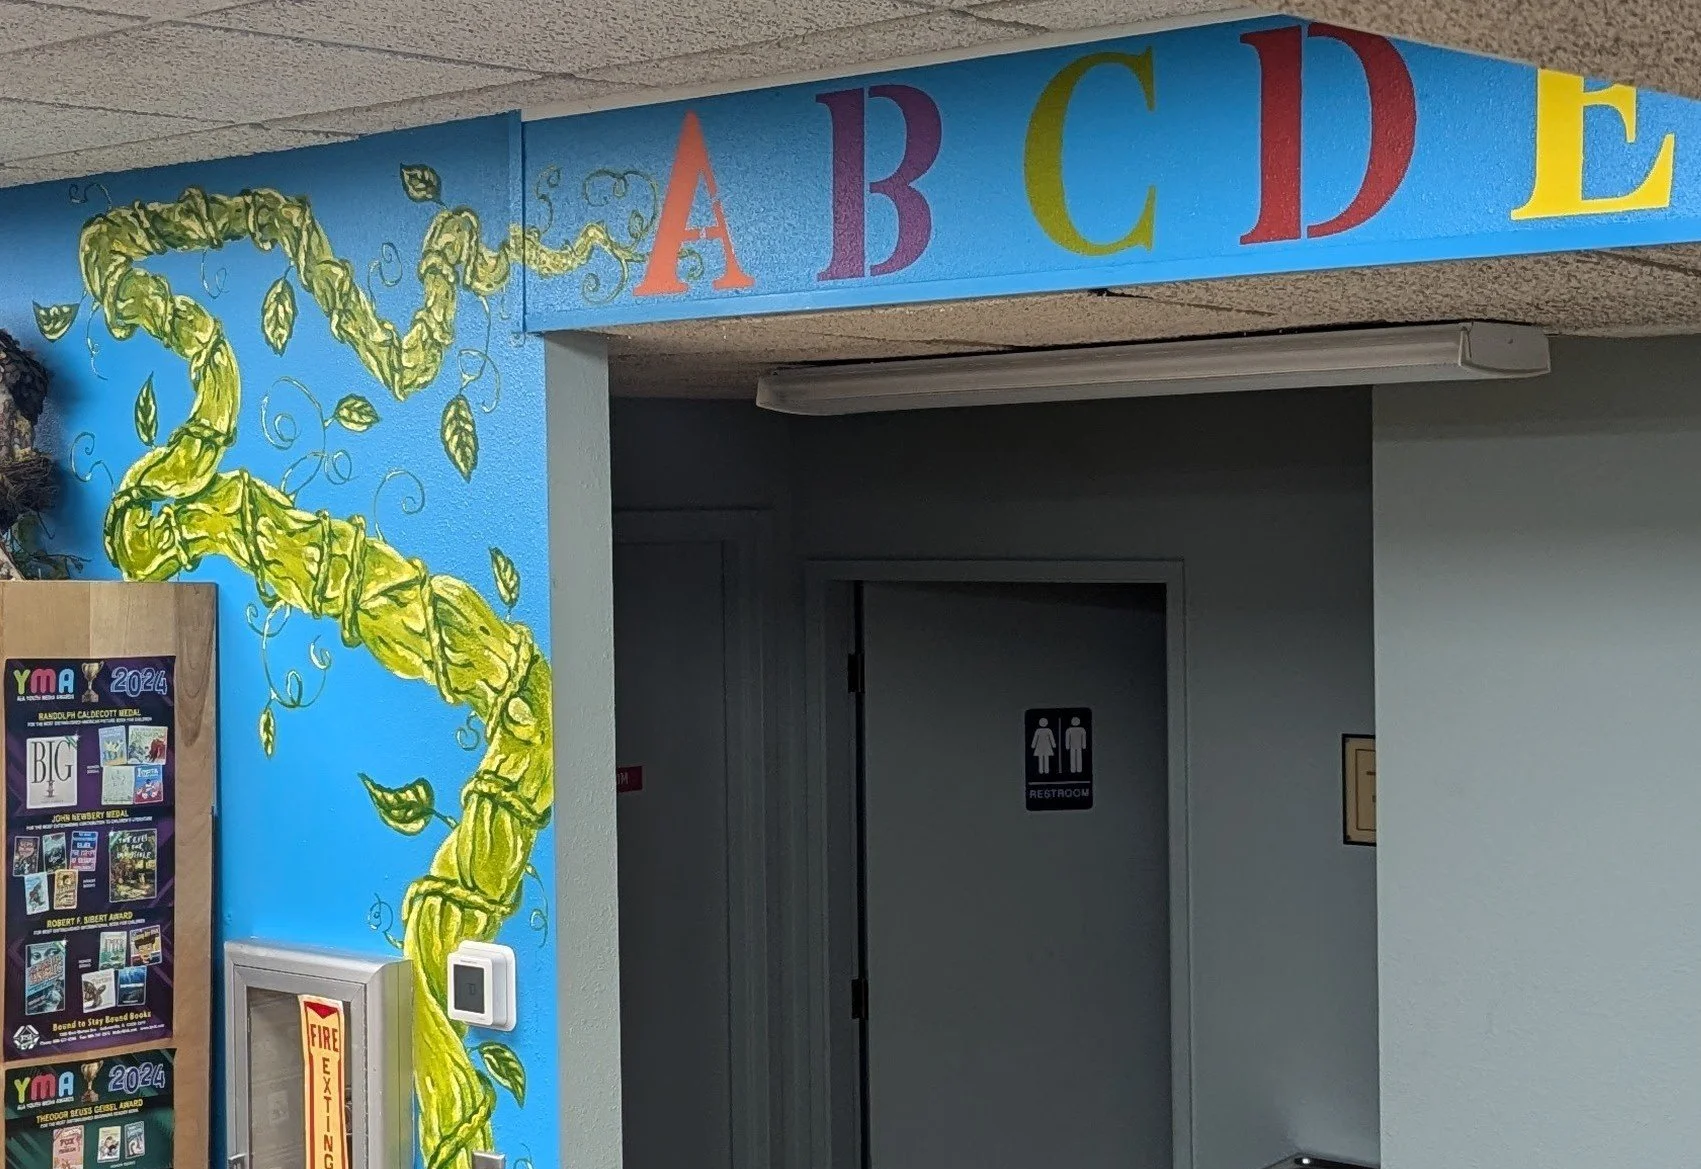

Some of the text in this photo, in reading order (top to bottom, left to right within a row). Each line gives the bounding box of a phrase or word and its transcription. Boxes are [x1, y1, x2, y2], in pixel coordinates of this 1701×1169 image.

[633, 22, 1675, 296] A B C D E
[13, 668, 74, 695] YMA
[110, 666, 168, 698] 2024
[38, 708, 141, 720] RANDOLPH CALDECOTT MEDAL
[30, 740, 73, 784] BIG
[1029, 788, 1089, 799] RESTROOM
[52, 814, 70, 823] JOHN
[72, 811, 105, 821] NEWBERY
[106, 809, 129, 818] MEDAL
[46, 917, 75, 928] ROBERT
[108, 911, 133, 921] AWARD
[52, 1010, 152, 1031] Bound to Stay Bound Books
[309, 1023, 339, 1053] FIRE
[14, 1071, 74, 1103] YMA
[108, 1061, 165, 1094] 2024
[36, 1111, 69, 1124] THEODOR
[70, 1107, 93, 1117] SEUSS
[94, 1104, 117, 1113] GEISEL
[119, 1099, 143, 1109] AWARD
